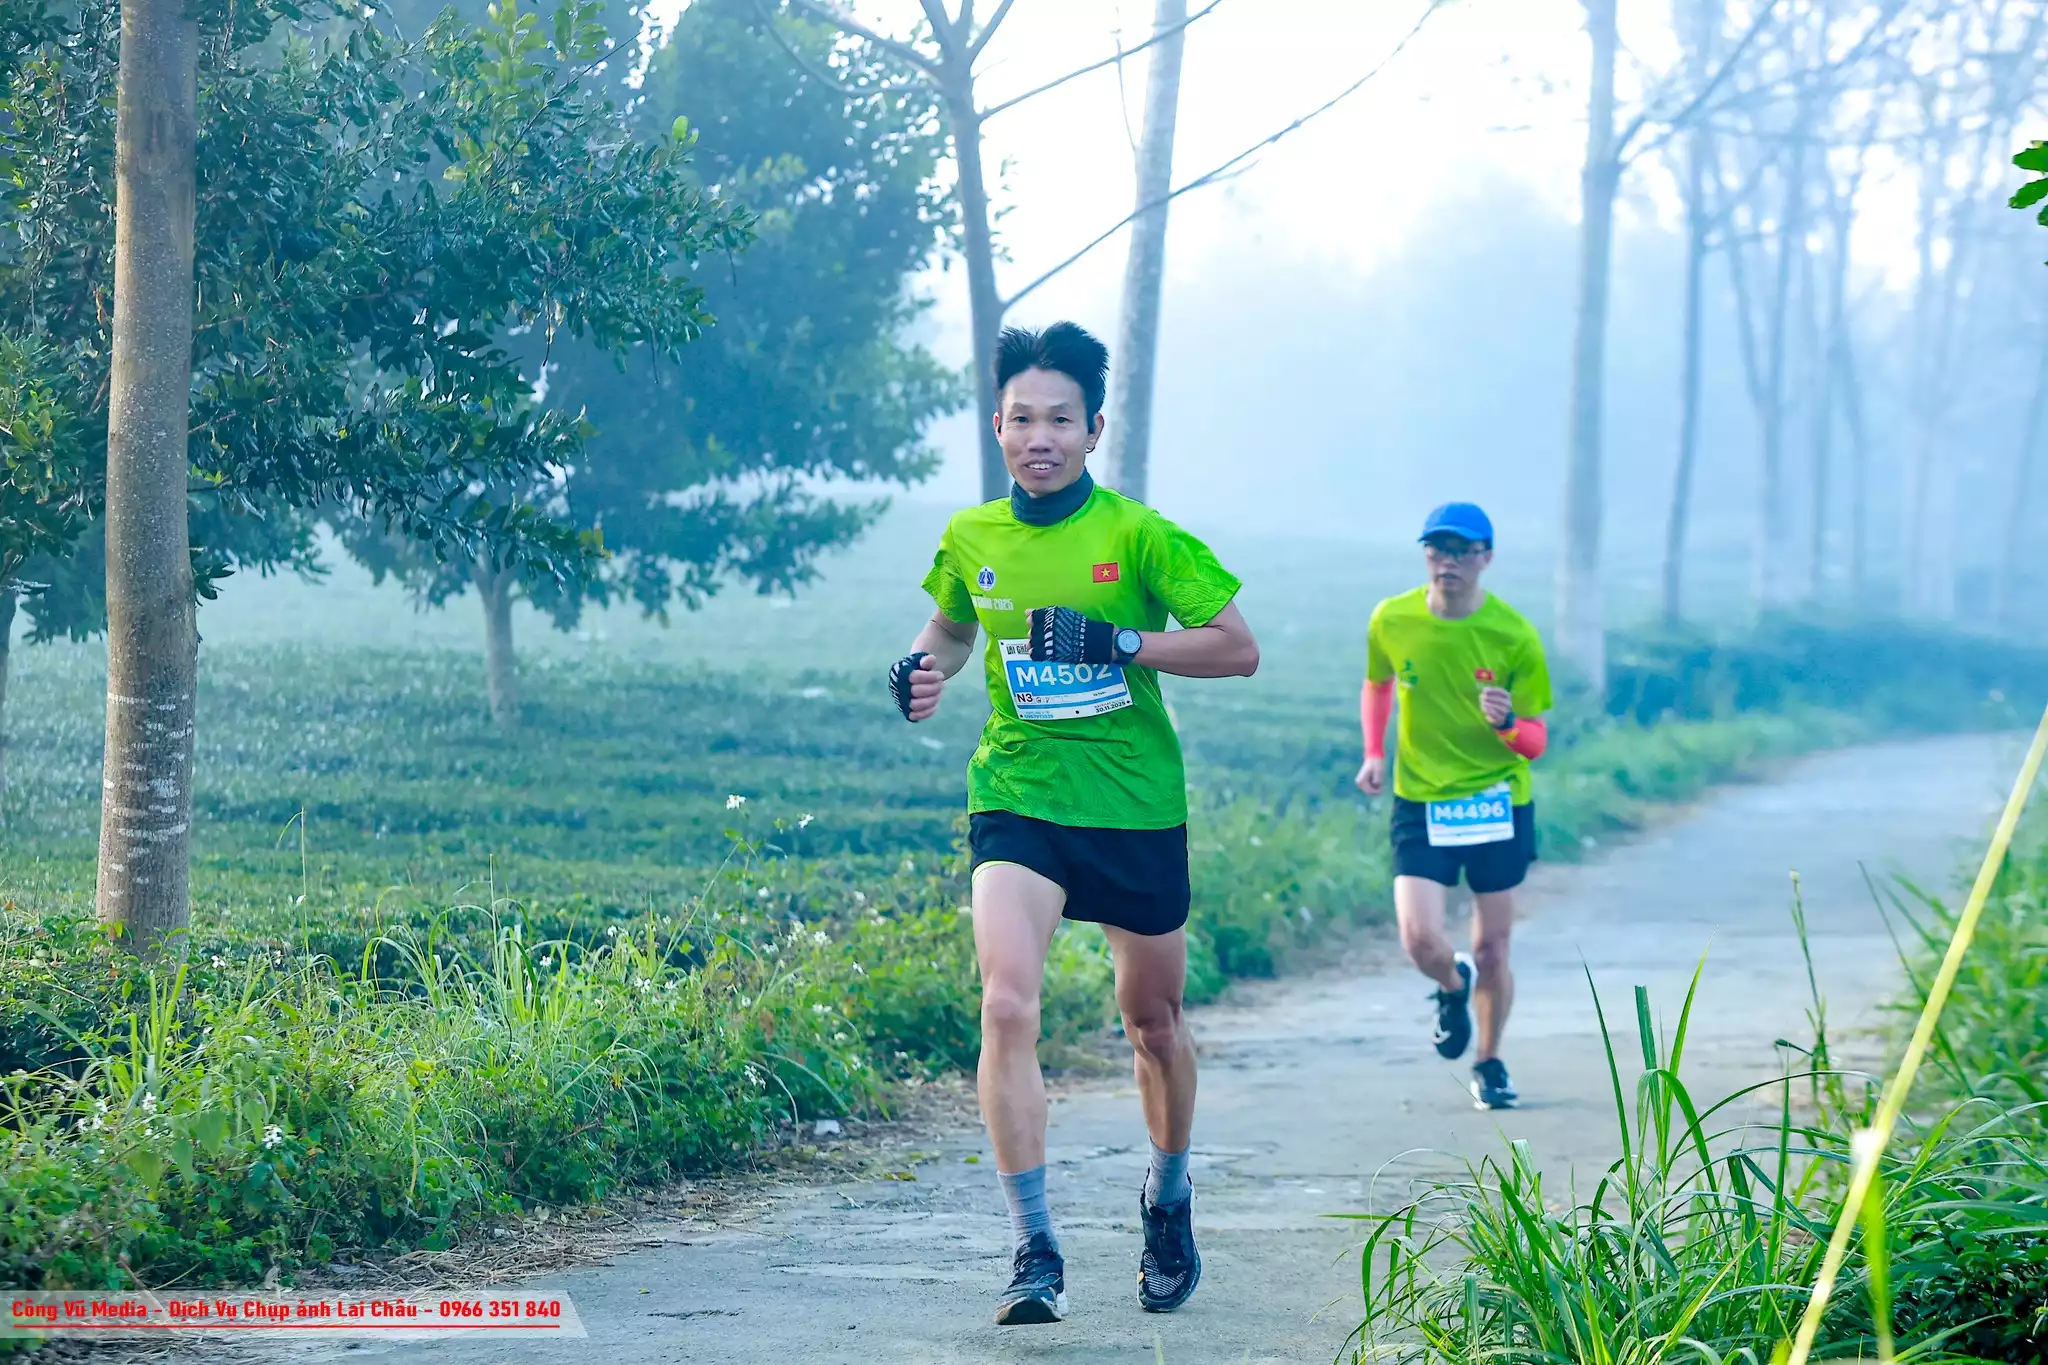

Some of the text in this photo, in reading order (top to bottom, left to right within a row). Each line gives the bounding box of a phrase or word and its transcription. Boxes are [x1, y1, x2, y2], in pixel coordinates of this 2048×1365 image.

[1016, 663, 1112, 687] M4502
[1016, 693, 1033, 703] N3
[1434, 800, 1506, 821] M4496
